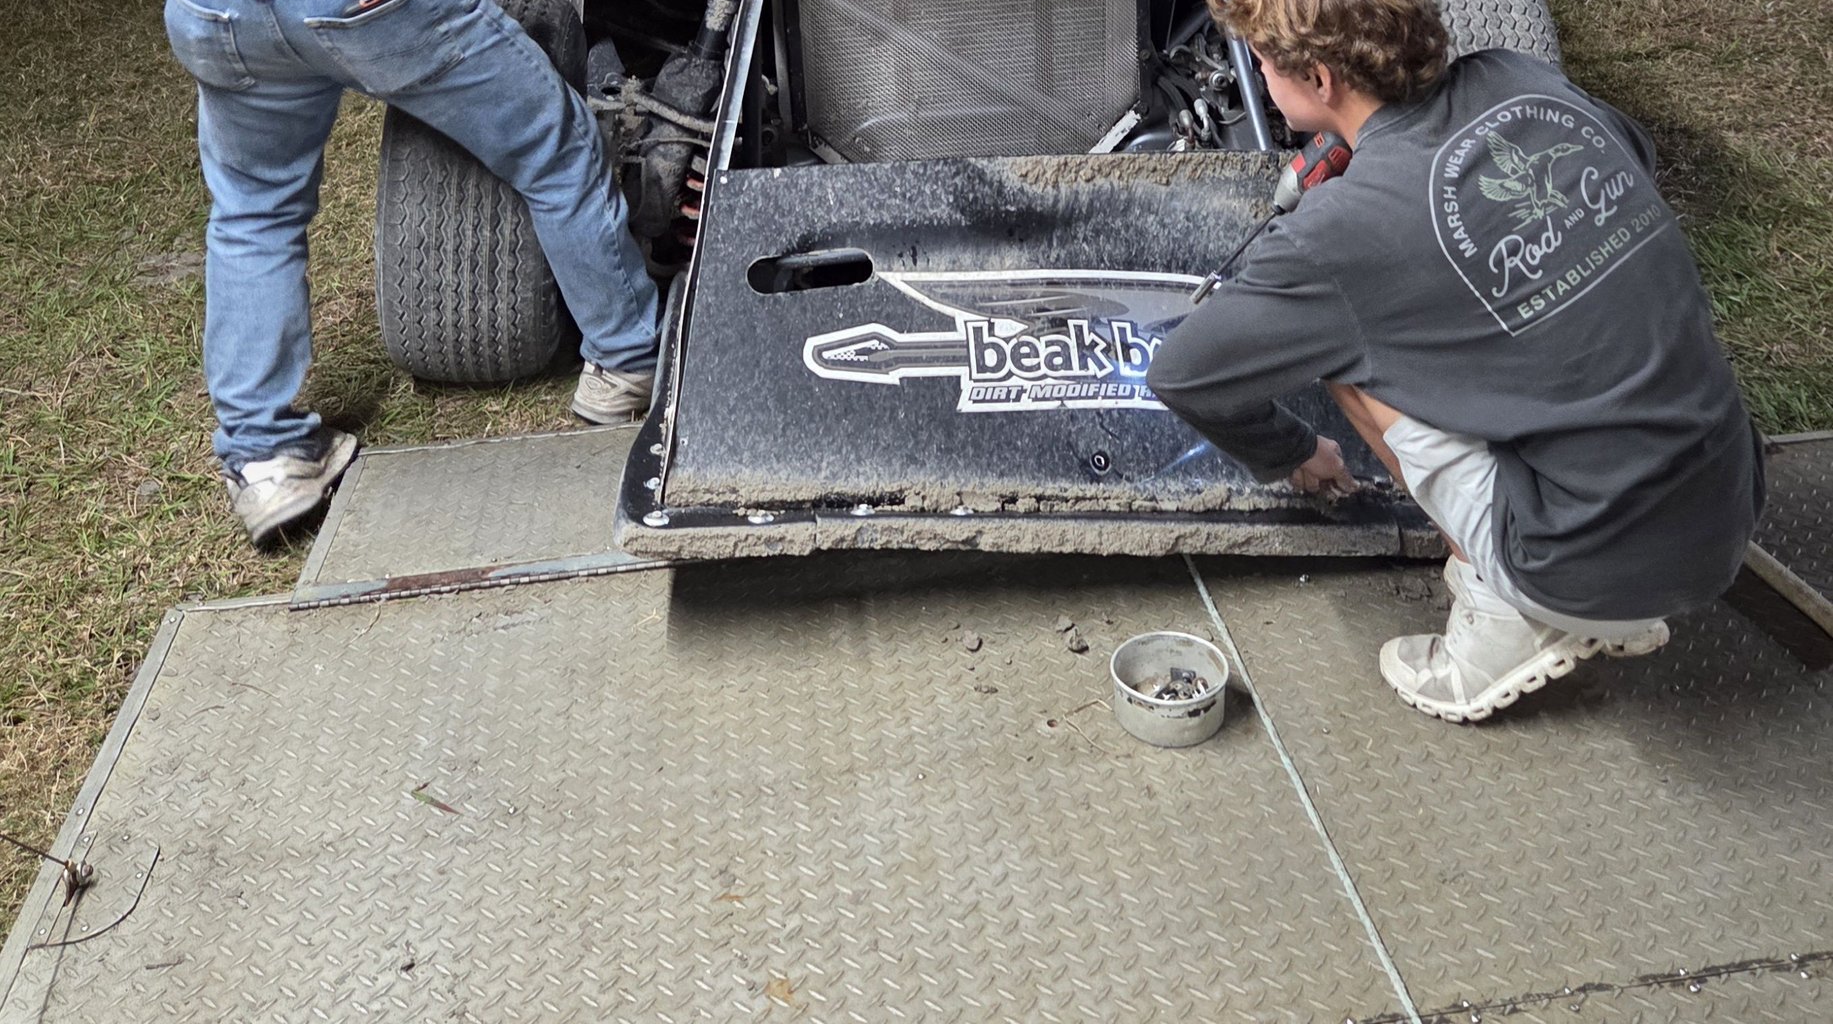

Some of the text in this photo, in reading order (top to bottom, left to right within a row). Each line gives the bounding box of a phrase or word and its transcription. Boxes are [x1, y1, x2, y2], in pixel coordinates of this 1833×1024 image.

[1443, 105, 1606, 258] MARSH WEAR CLOTHING CO.
[1488, 166, 1634, 298] Rod AND Gun
[1516, 205, 1662, 320] ESTABLISHED 2010
[966, 319, 1114, 378] beak
[970, 385, 1023, 400] DIRT
[1029, 383, 1132, 399] MODIFIED
